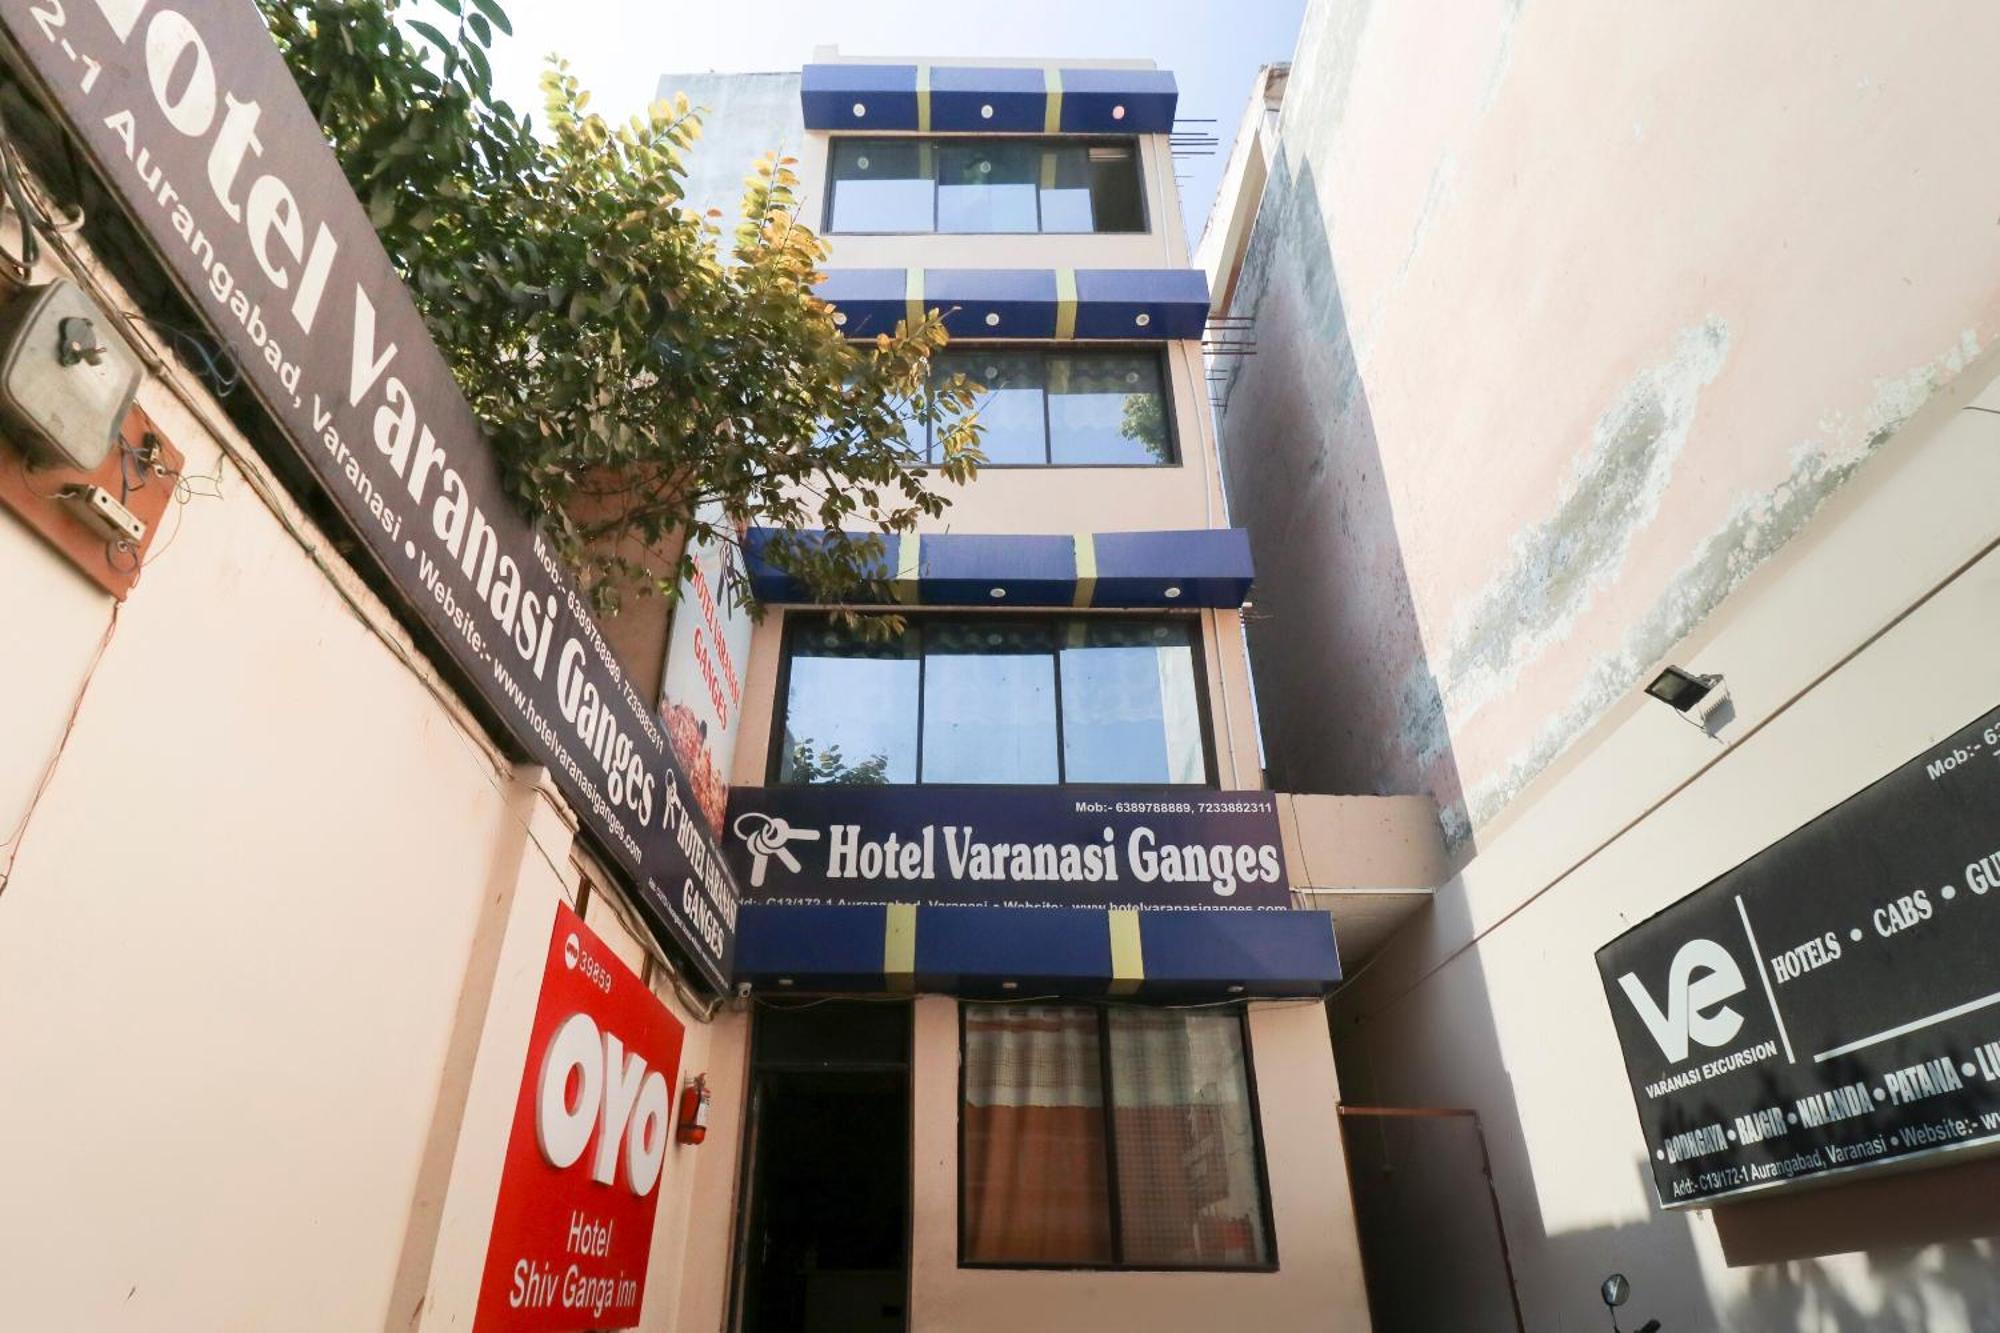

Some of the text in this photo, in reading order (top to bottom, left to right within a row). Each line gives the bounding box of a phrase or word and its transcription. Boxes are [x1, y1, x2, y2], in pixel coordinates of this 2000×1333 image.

[104, 110, 301, 408] Aurangabad,
[312, 394, 402, 541] Varanasi
[419, 550, 491, 661] Website:-
[493, 657, 642, 864] www.hotelvaranasiganges.com
[350, 281, 557, 681] Varanasi
[557, 637, 655, 826] Ganges
[534, 534, 664, 754] Mob:- 6389788889, 7233882311
[1926, 744, 1981, 780] Mob:-
[677, 805, 706, 881] HOTEL
[1075, 802, 1272, 815] Mob:- 6389788889, 7233882311
[826, 824, 1280, 896] Hotel Varanasi Ganges
[683, 877, 724, 960] GANGES
[1771, 851, 2000, 982] HOTELS CABS GU
[580, 950, 612, 993] 39859
[536, 1013, 669, 1197] OYO
[1645, 1041, 1778, 1099] VARANASI EXCURSION
[1734, 1107, 1788, 1146] RAJGIR
[1795, 1082, 1875, 1129] NALANDA
[1883, 1056, 1963, 1106] PATANA
[1973, 1040, 2000, 1081] LU
[1673, 1178, 1699, 1198] Add:-
[1700, 1165, 1748, 1190] C13/172-1
[1751, 1148, 1827, 1180] Aurangabad,
[1825, 1134, 1887, 1164] Varanasi
[1900, 1117, 1978, 1147] Website:-
[566, 1210, 613, 1257] Hotel
[509, 1258, 637, 1318] Shiv Ganga inn
